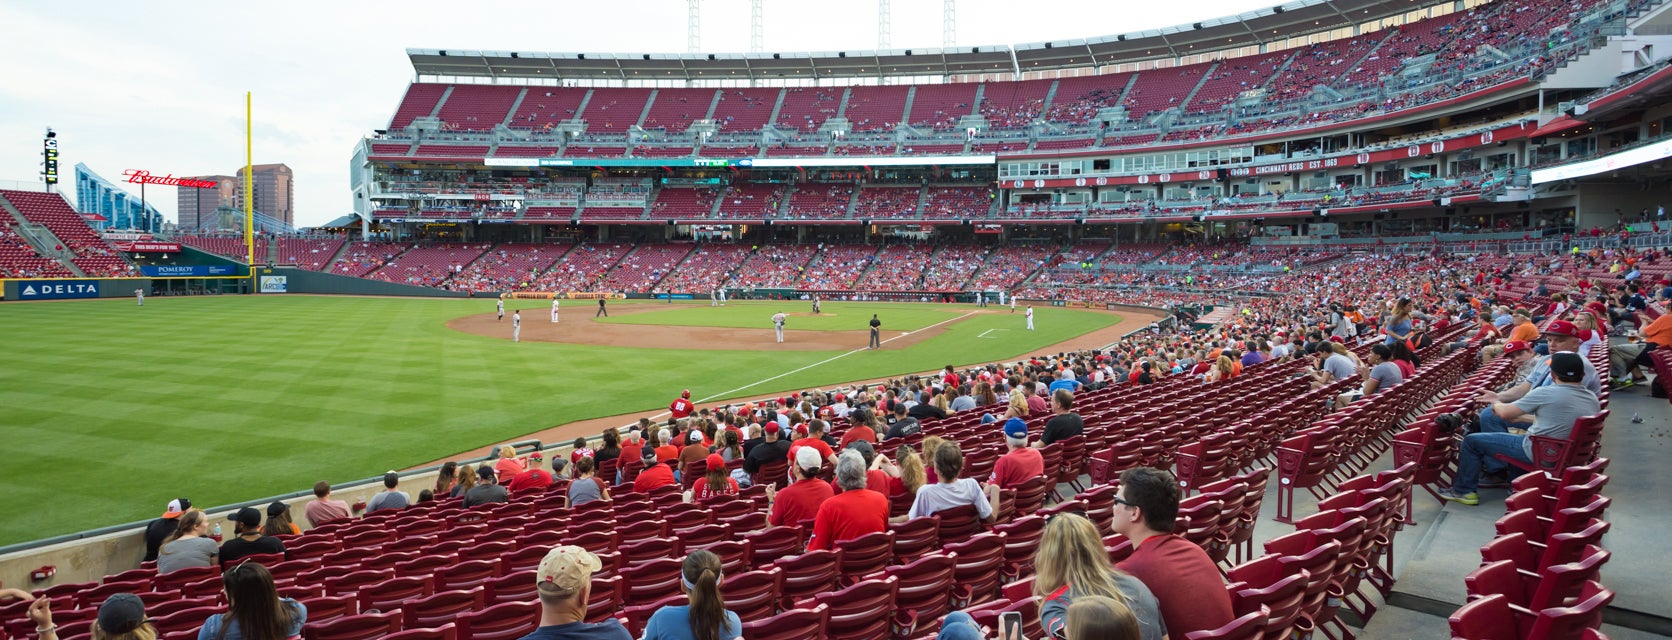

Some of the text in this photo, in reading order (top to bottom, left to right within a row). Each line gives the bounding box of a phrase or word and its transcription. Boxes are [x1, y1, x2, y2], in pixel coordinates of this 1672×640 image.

[1255, 158, 1338, 174] CINCINNATI REDS EST. 1869
[124, 169, 217, 188] Budweiser
[41, 284, 97, 294] DELTA
